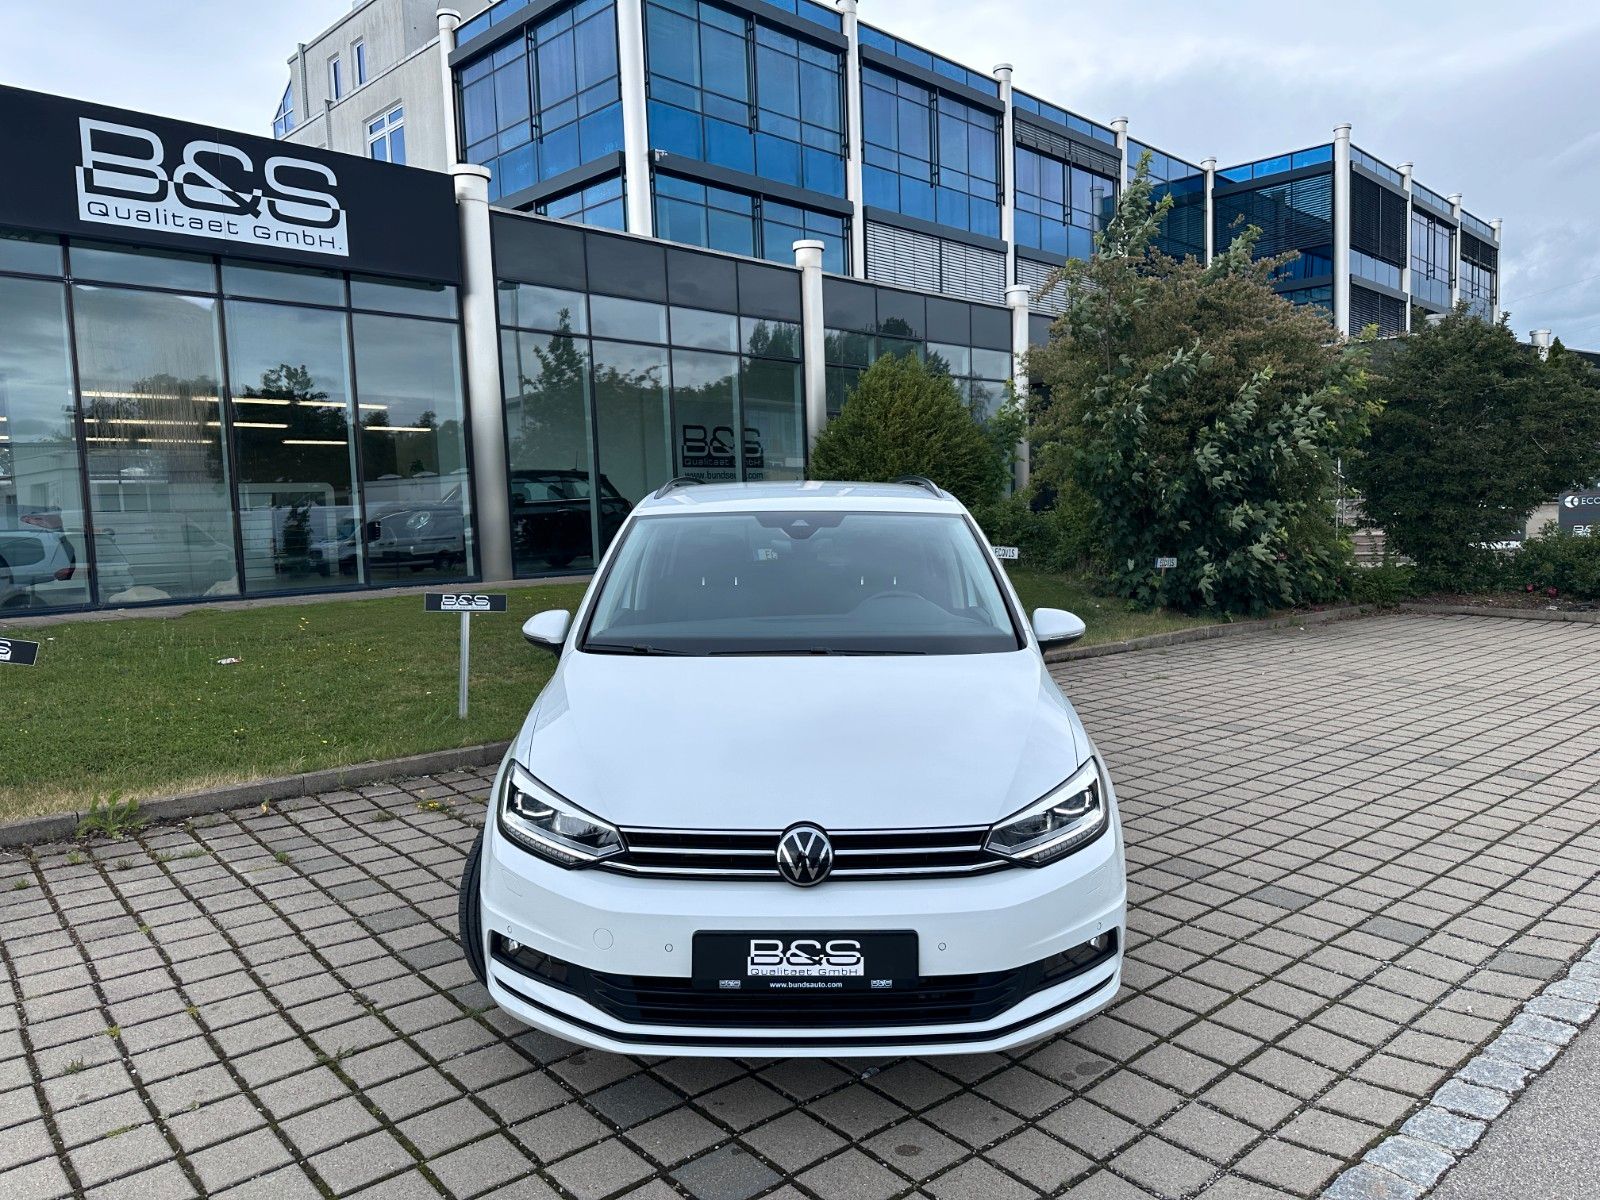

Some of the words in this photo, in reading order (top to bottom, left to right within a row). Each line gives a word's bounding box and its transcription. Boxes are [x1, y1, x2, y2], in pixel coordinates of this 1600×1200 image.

[77, 116, 341, 229] B&S
[87, 201, 239, 236] Qualitaet
[442, 594, 489, 606] B&S
[749, 939, 862, 967] B&S
[750, 967, 813, 976] Qualitaet
[769, 981, 843, 989] www.bundsauto.com
